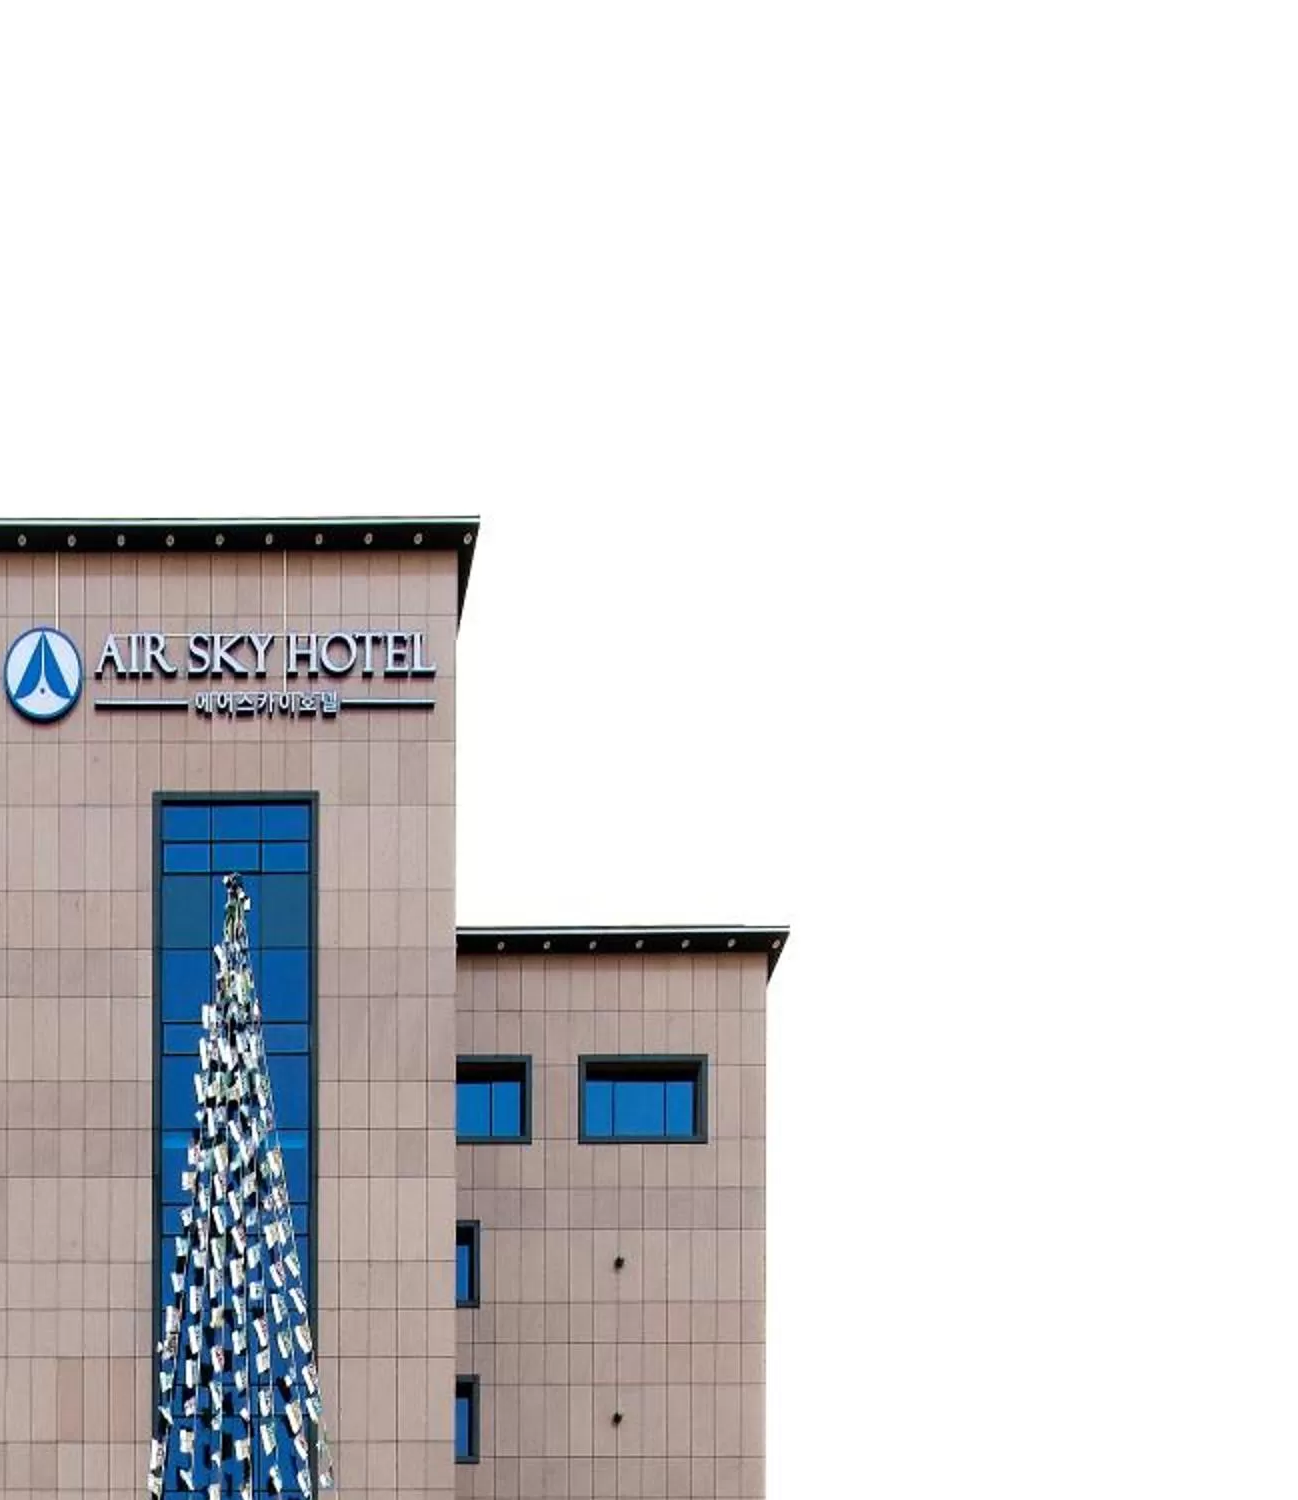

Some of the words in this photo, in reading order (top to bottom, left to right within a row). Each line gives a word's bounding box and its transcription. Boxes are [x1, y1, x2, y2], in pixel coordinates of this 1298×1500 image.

[93, 632, 179, 677] AIR
[187, 632, 275, 677] SKY
[286, 632, 437, 677] HOTEL
[194, 690, 338, 716] 에어스카이호텔
